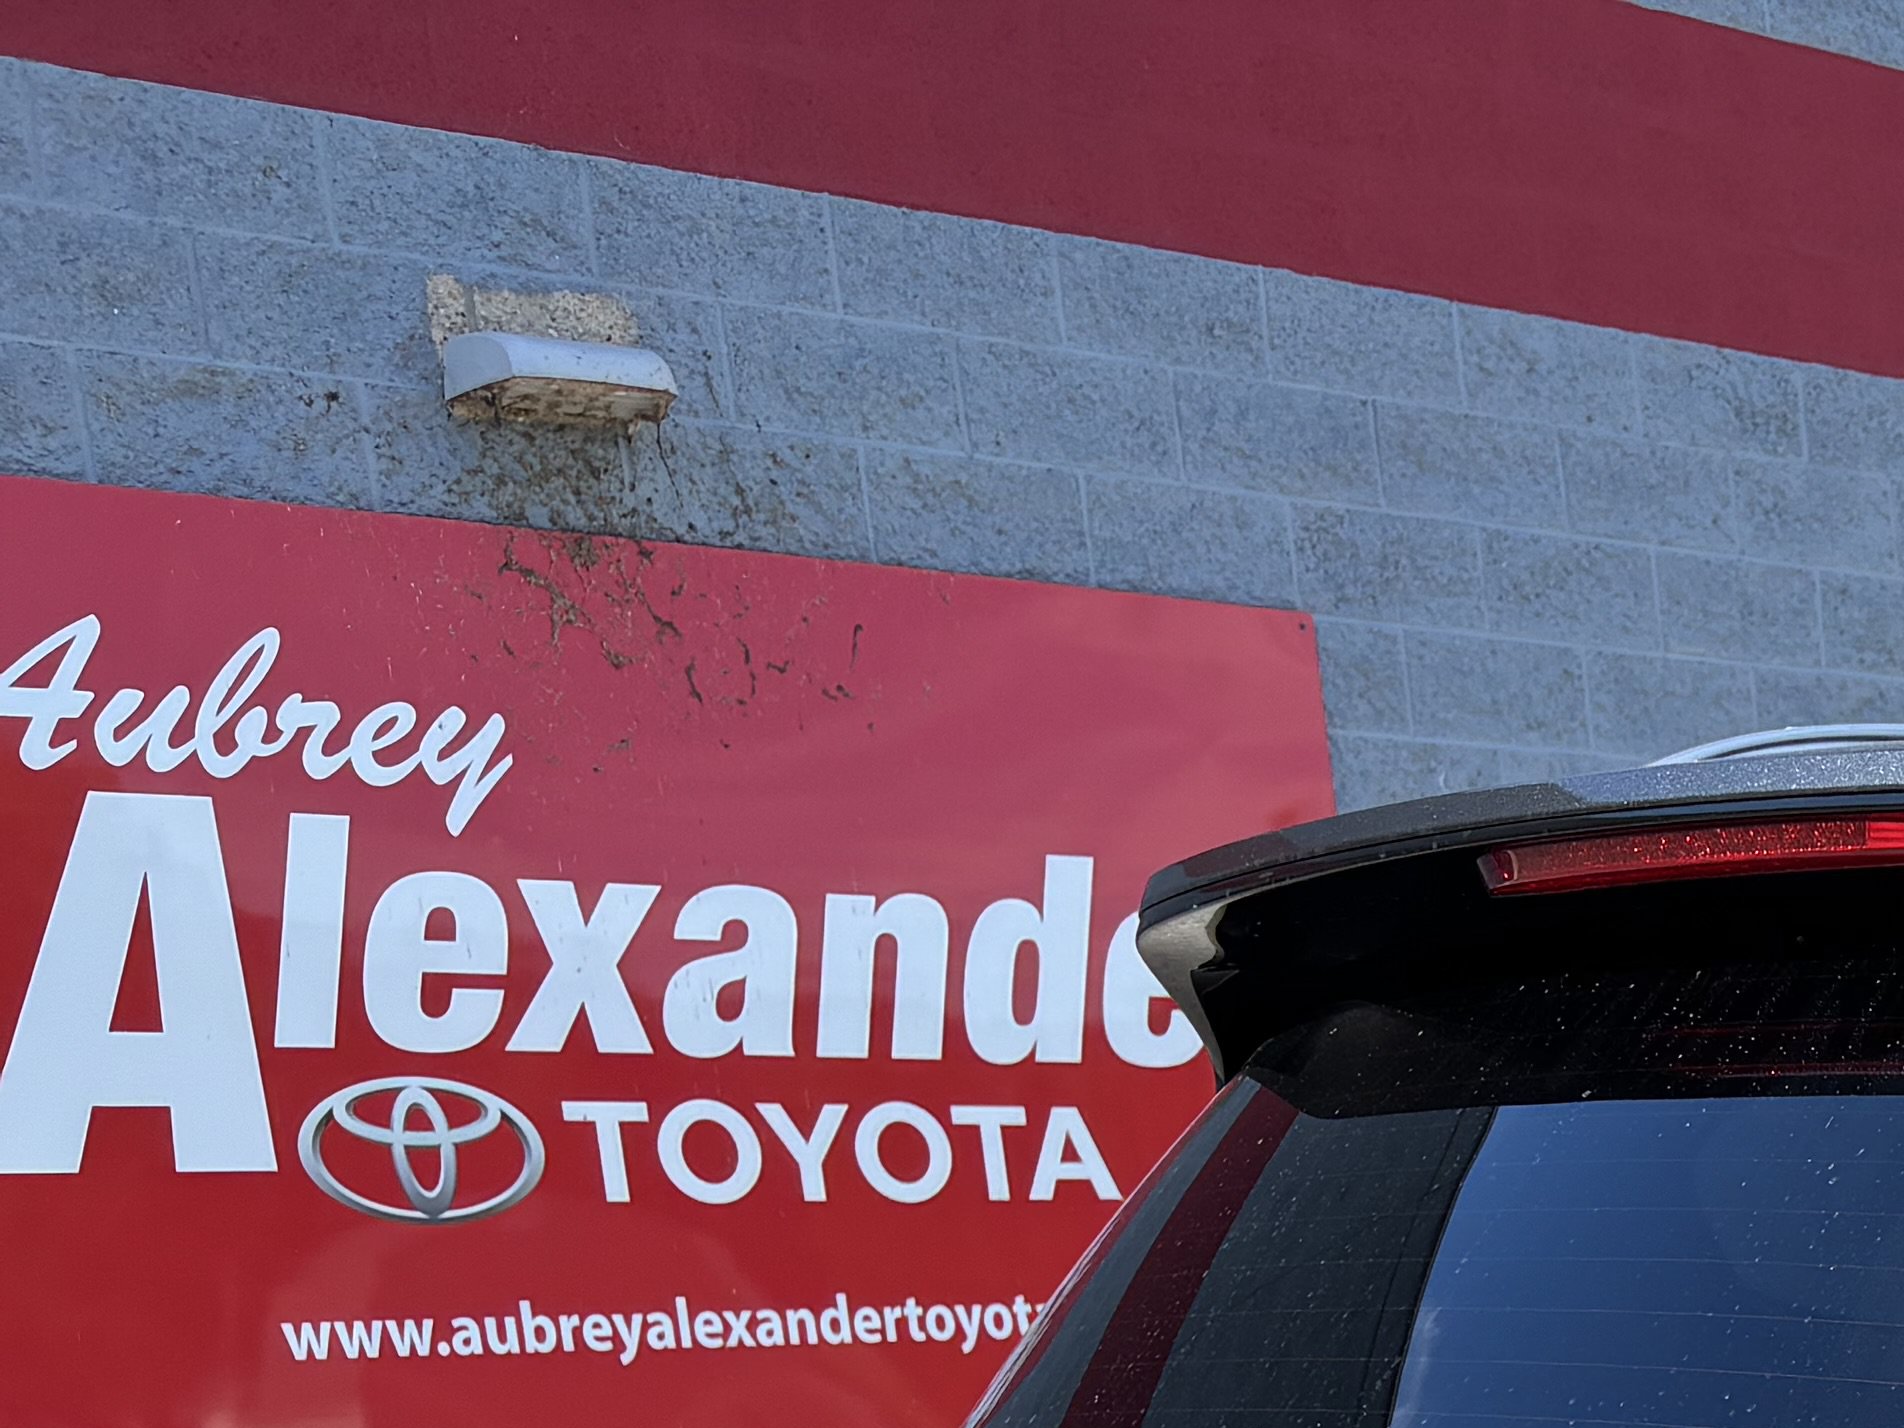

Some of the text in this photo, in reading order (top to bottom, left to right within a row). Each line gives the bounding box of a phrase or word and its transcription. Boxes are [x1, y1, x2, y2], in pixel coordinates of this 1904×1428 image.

[0, 613, 513, 838] Aubrey
[562, 1099, 1124, 1204] TOYOTA
[280, 1291, 1046, 1367] www.aubreyalexandertoyot
